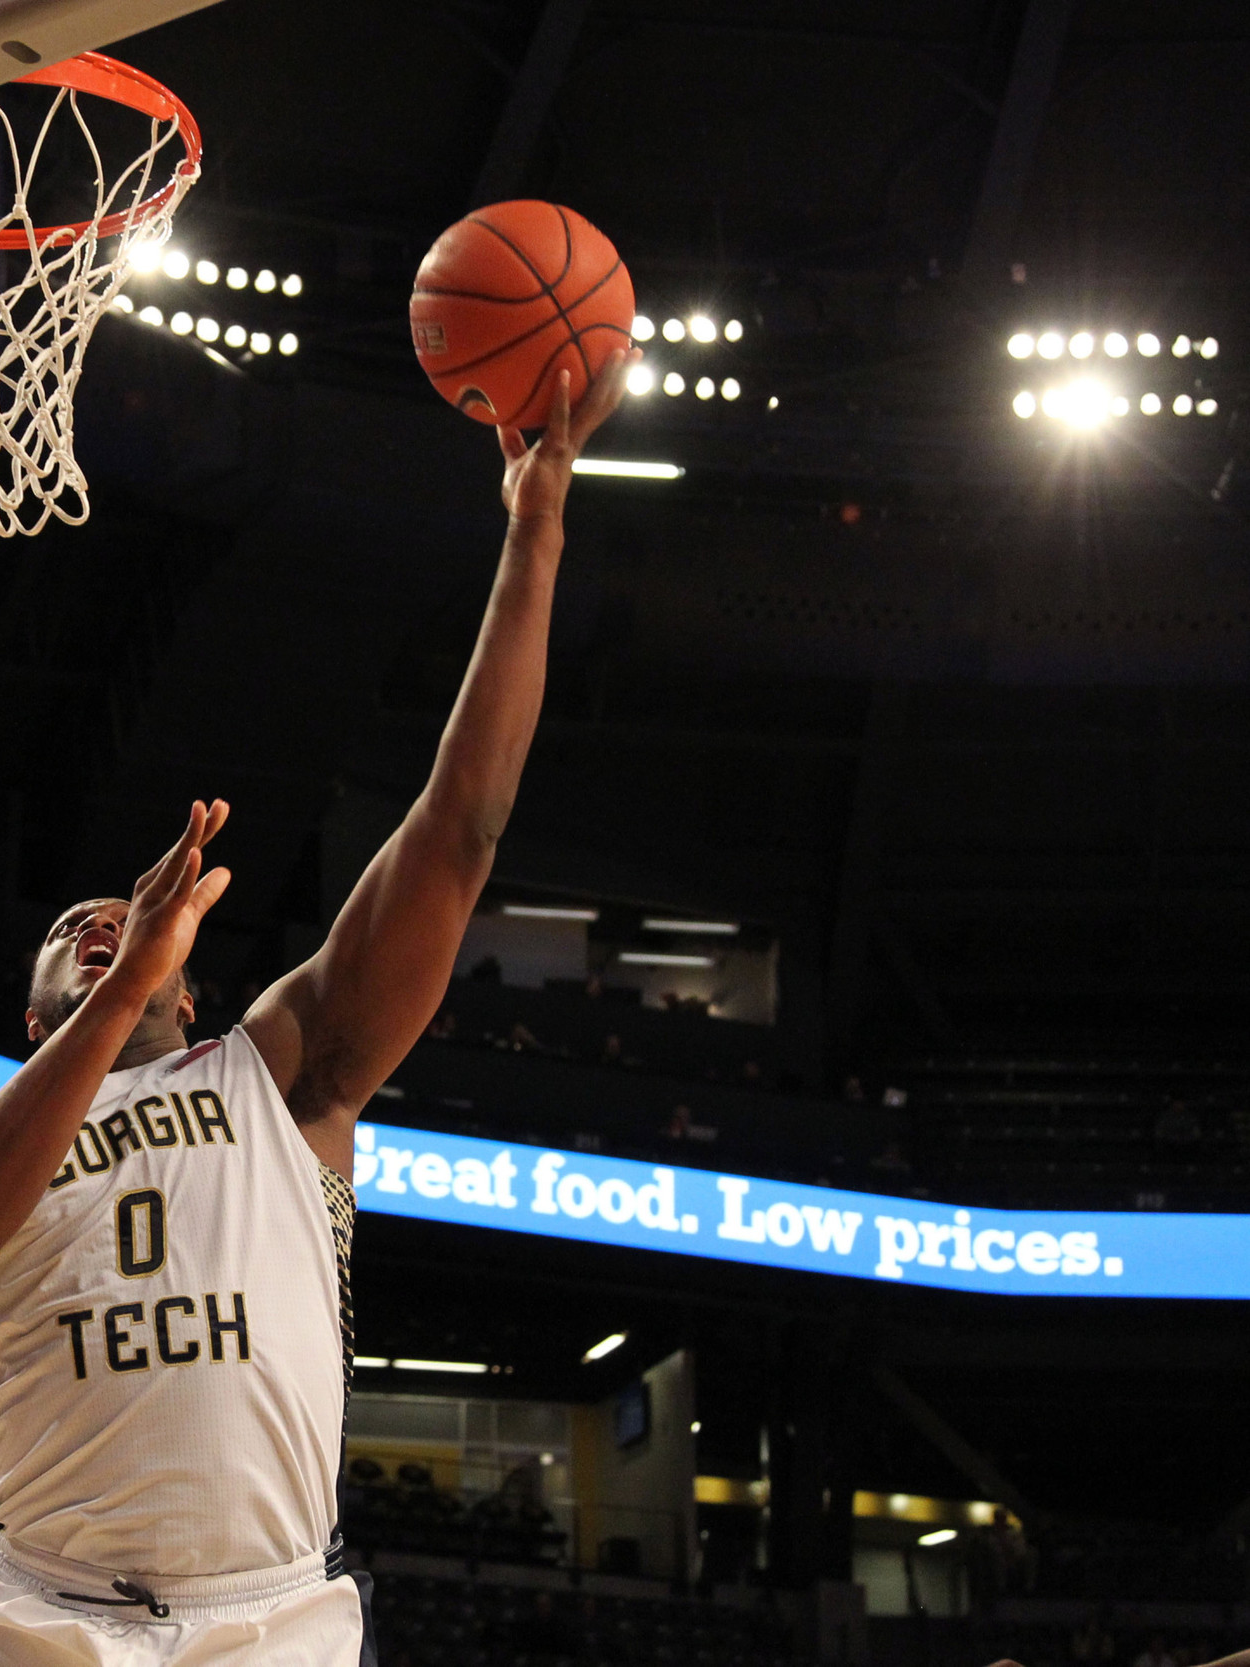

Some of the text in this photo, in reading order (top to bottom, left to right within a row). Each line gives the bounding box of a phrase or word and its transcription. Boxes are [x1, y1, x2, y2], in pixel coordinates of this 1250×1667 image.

[49, 1088, 238, 1191] ORGIA
[113, 1186, 169, 1280] 0
[530, 1152, 699, 1235] food.
[717, 1176, 864, 1256] Low
[874, 1208, 1125, 1280] prices.
[56, 1291, 252, 1380] TECH
